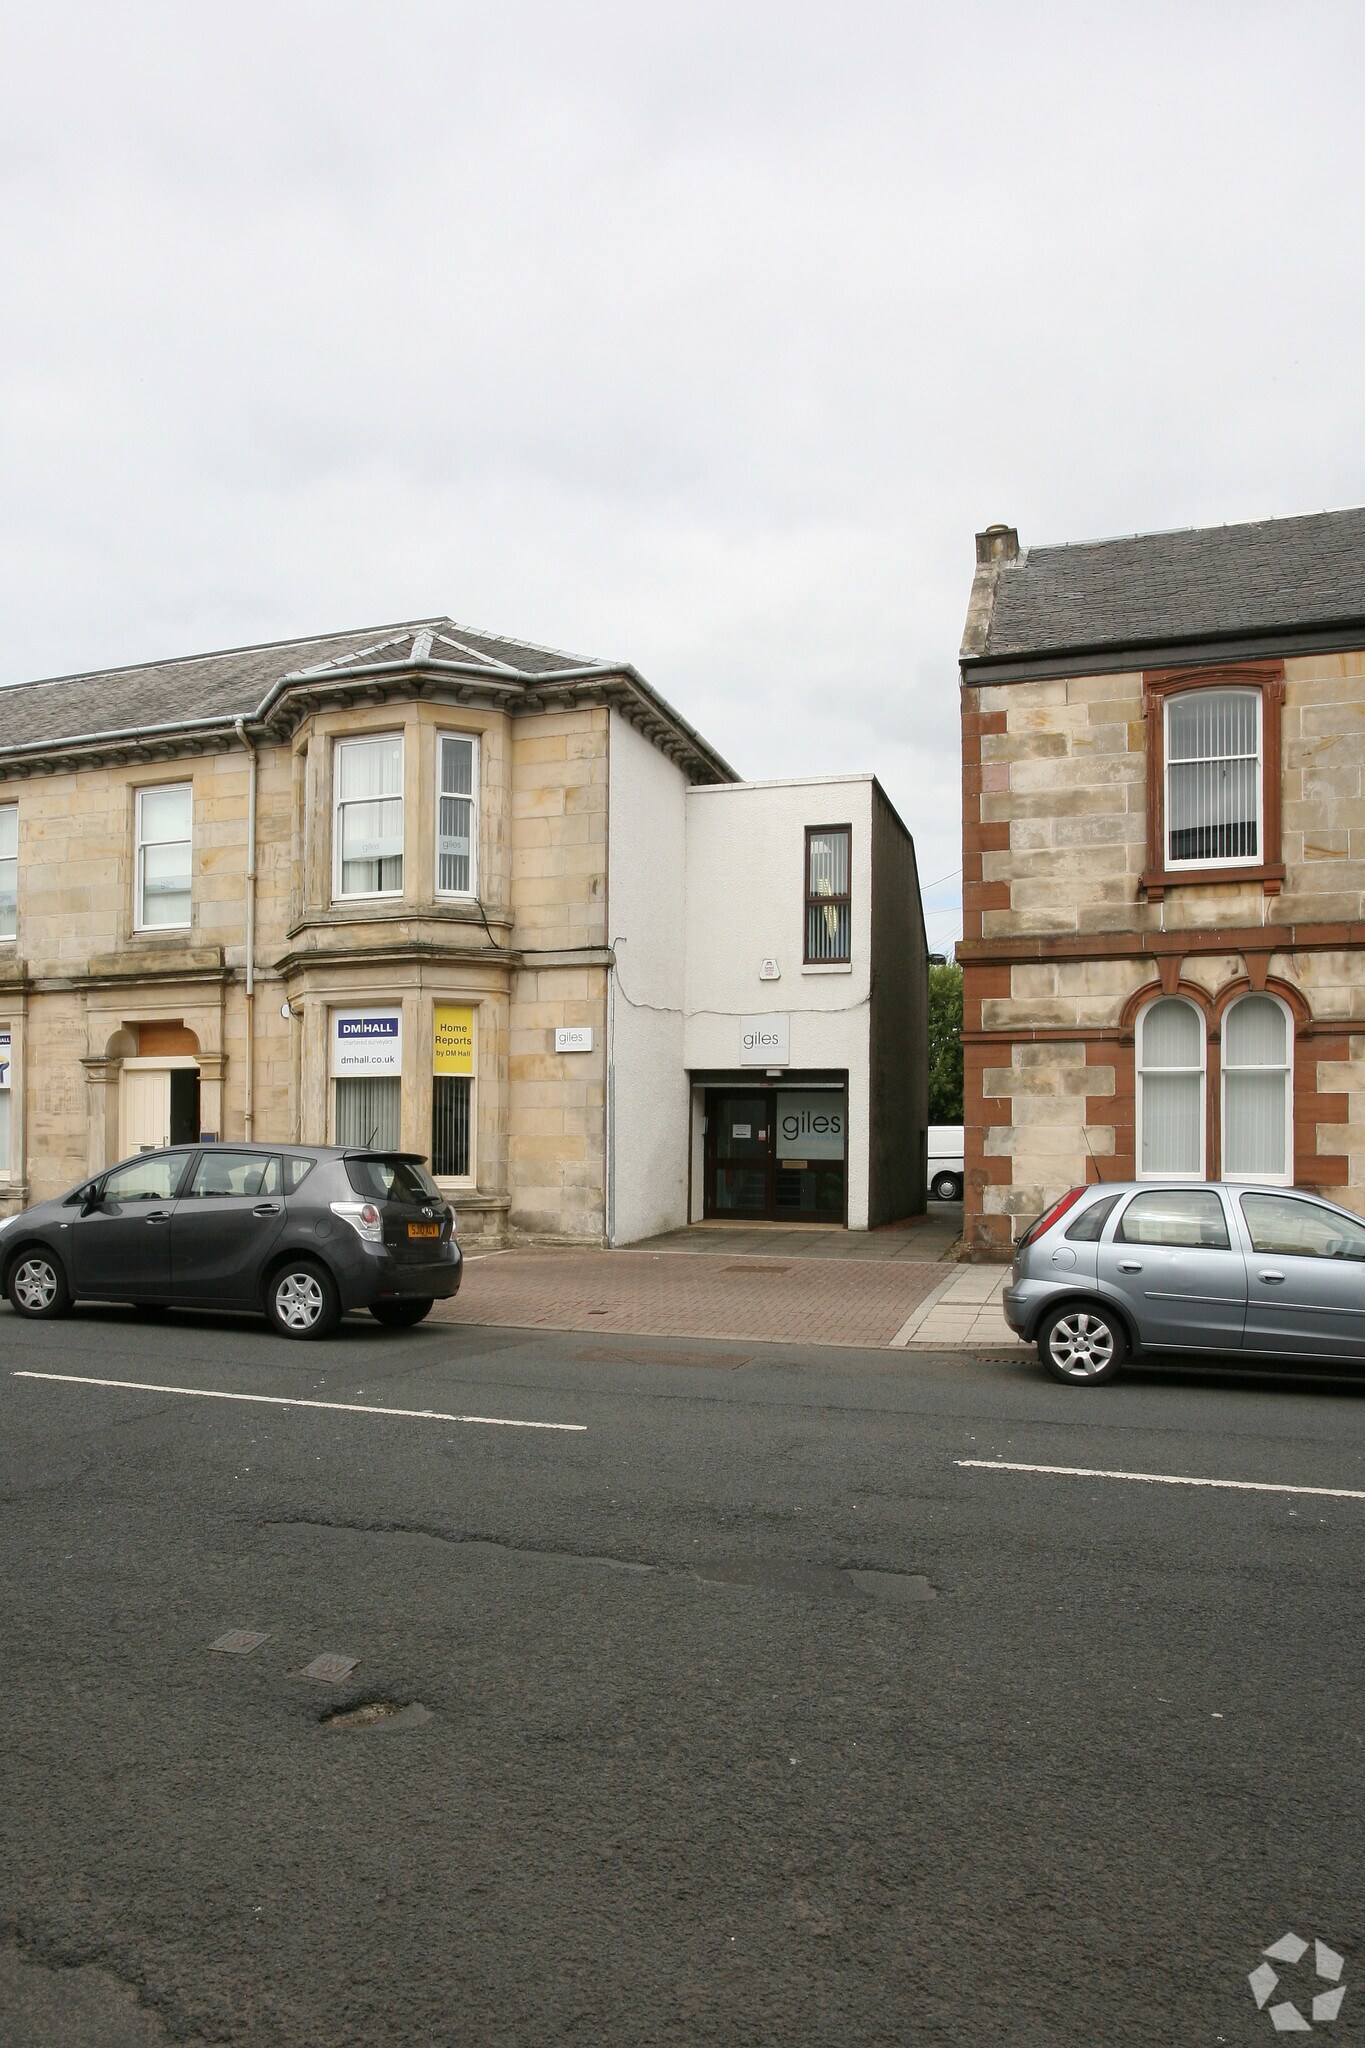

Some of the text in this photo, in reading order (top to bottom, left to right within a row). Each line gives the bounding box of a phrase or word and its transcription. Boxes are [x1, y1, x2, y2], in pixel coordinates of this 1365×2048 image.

[443, 840, 462, 850] giles
[440, 1023, 468, 1033] Home
[435, 1035, 472, 1046] Reports
[558, 1032, 583, 1046] giles
[743, 1031, 779, 1050] giles
[436, 1049, 444, 1057] by
[341, 1055, 395, 1065] dmhall.co.uk
[782, 1110, 841, 1141] giles
